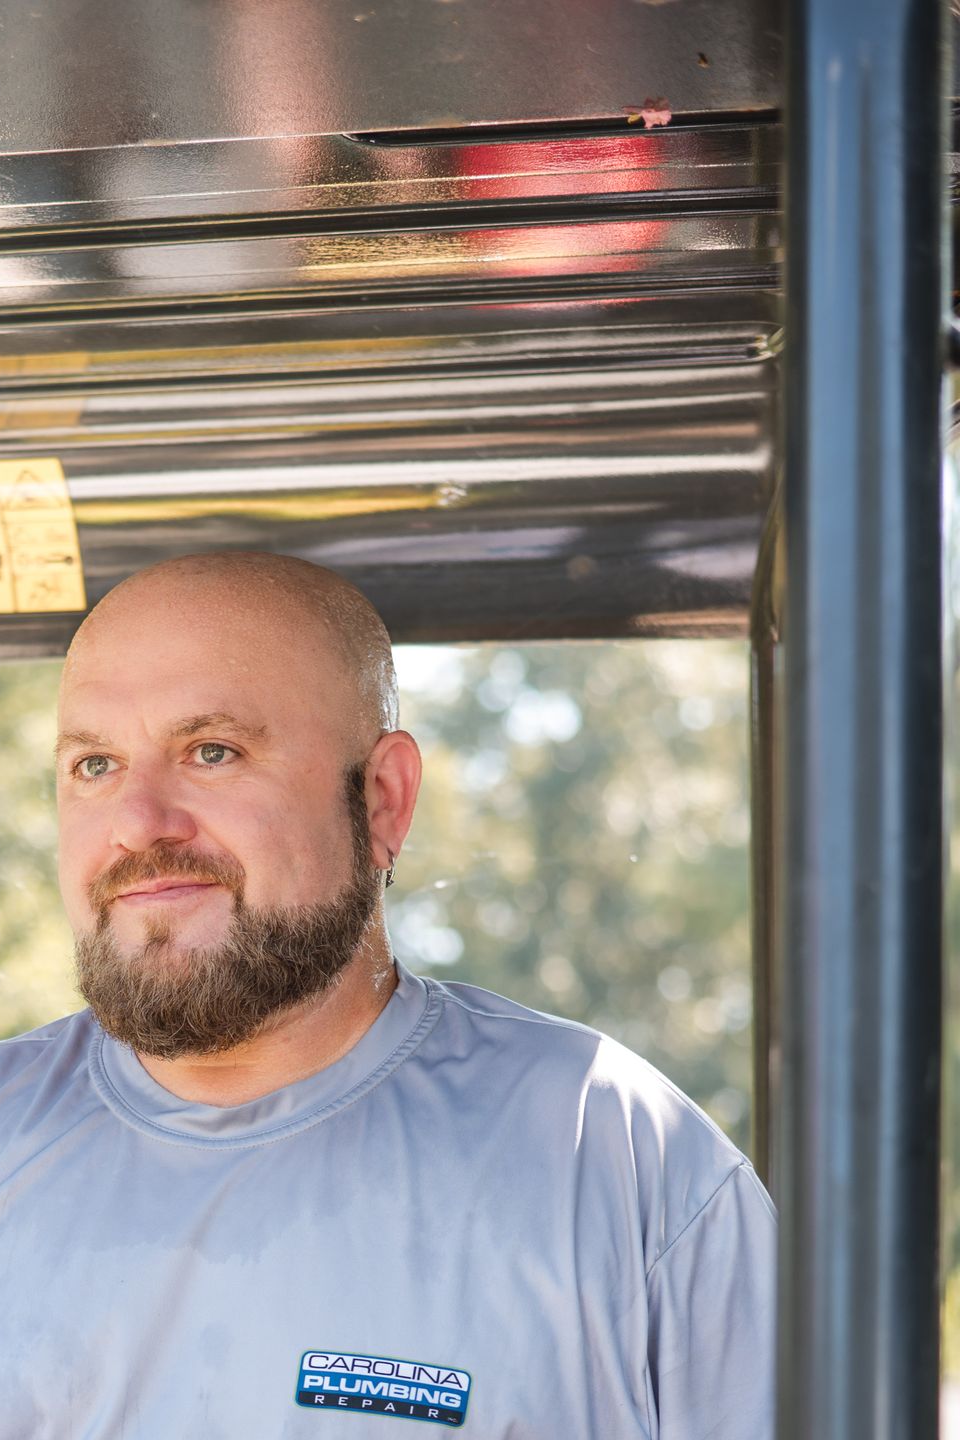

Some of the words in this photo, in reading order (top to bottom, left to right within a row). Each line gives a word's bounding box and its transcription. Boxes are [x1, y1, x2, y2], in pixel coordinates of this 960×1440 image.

[308, 1354, 463, 1389] CAROLINA
[303, 1374, 462, 1408] PLUMBING
[314, 1394, 439, 1418] REPAIR
